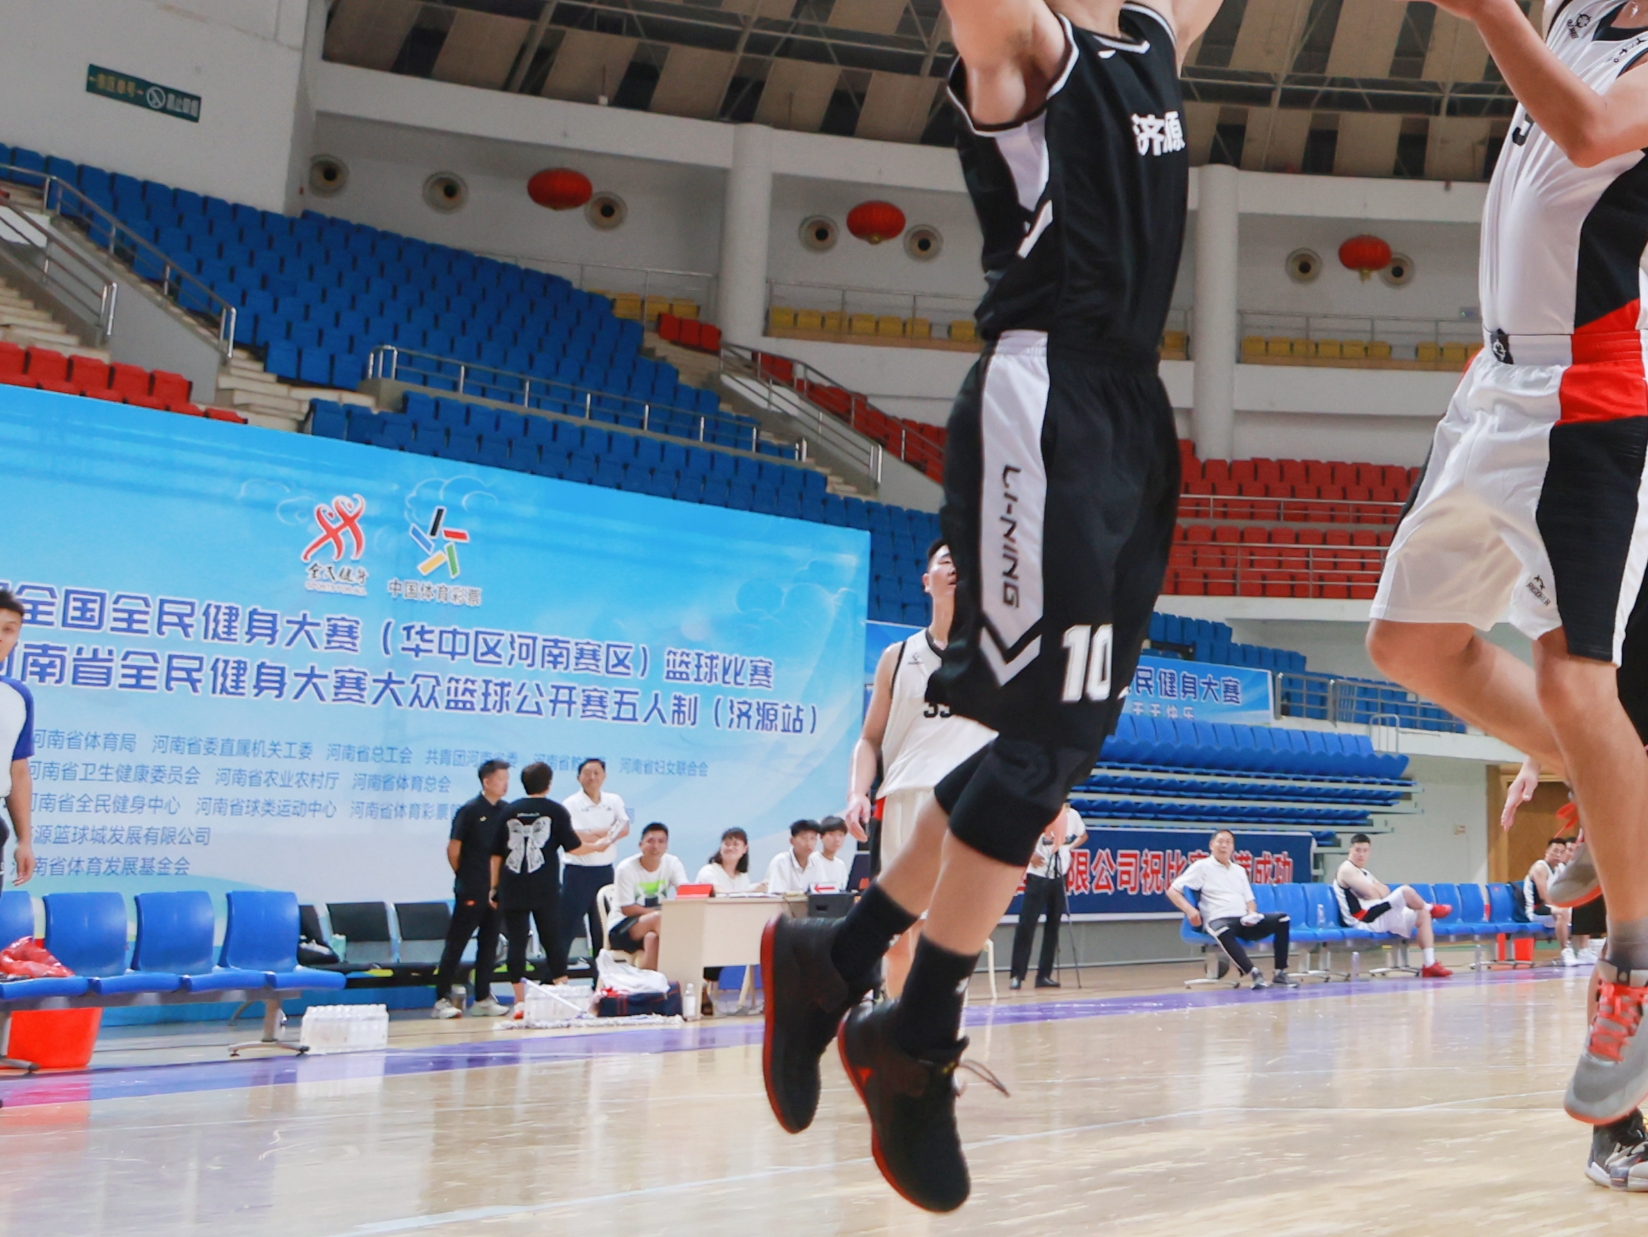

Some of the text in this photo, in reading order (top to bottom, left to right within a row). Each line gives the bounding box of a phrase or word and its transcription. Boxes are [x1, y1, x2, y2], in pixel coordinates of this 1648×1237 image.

[999, 464, 1022, 609] LI-NING
[387, 578, 482, 606] 中国体育彩票
[0, 581, 774, 690] 全国全民健身大赛（华中区河南赛区）篮球比赛
[1060, 623, 1113, 702] 10
[0, 640, 817, 735] 南省全民健身大赛大众篮球公开赛五人制（济源站）
[326, 743, 414, 766] 河南省总工会
[214, 767, 341, 792] 河南省农业农村厅
[352, 772, 452, 795] 河南省体育总会
[196, 796, 338, 820] 河南省球类运动中心
[349, 799, 459, 821] 河南省体育彩票
[31, 823, 212, 847] 源篮球城发展有限公司
[10, 855, 191, 878] 南省体育发展基金会
